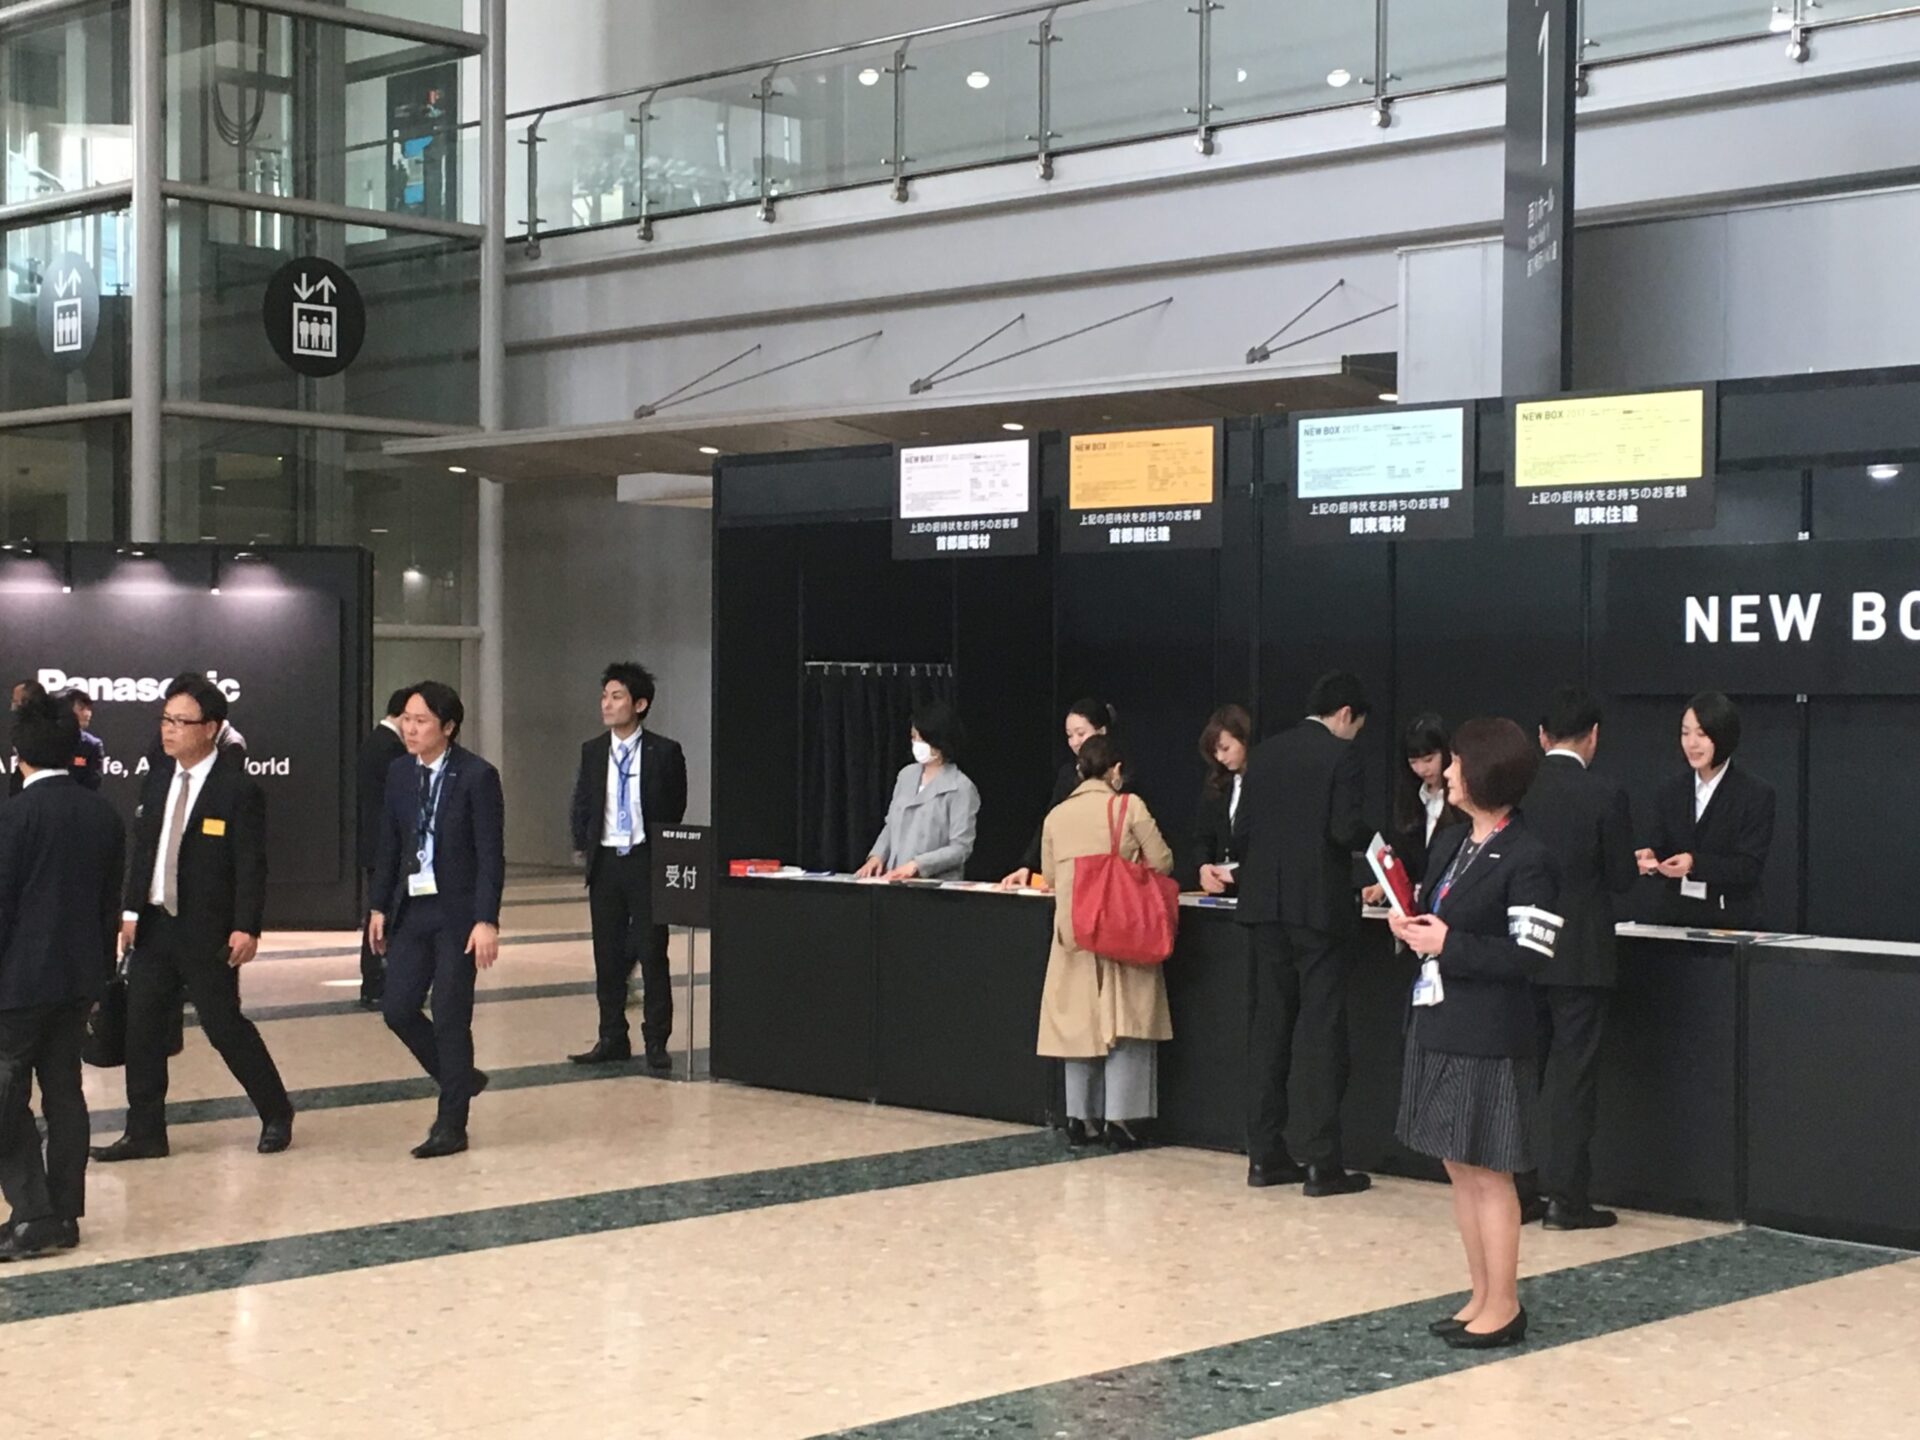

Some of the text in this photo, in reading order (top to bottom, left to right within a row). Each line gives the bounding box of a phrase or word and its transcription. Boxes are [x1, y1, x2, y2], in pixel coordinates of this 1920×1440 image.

[1303, 426, 1322, 436] NEW
[1323, 425, 1340, 435] BOX
[1309, 496, 1449, 515] 上記の招待状をお持ちのお客様
[1528, 485, 1687, 506] 上記の招待状をお持ちのお客様
[1350, 515, 1406, 534] 関東電材
[1574, 505, 1638, 526] 関東住建
[1684, 593, 1822, 643] NEW
[38, 668, 241, 703] Panasc
[244, 756, 289, 776] orld
[666, 865, 697, 890] 受付
